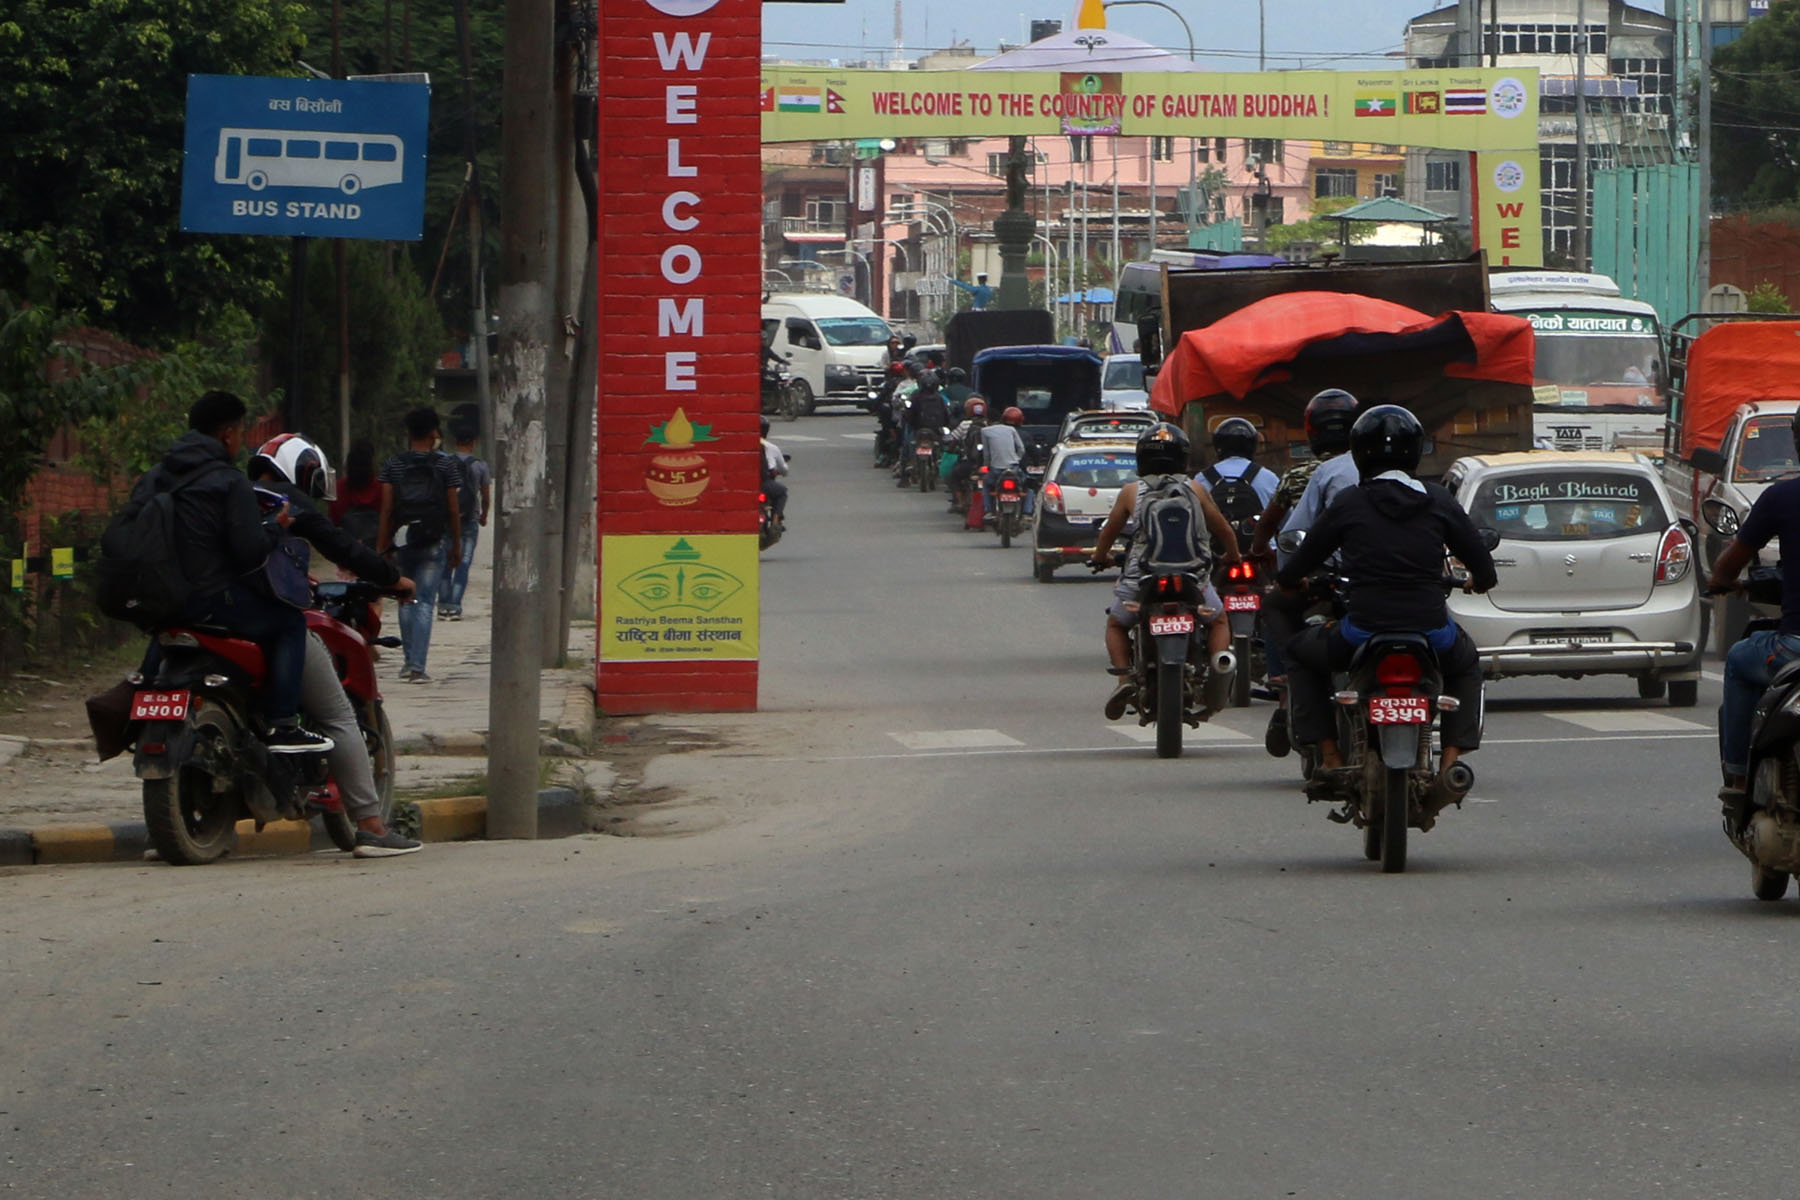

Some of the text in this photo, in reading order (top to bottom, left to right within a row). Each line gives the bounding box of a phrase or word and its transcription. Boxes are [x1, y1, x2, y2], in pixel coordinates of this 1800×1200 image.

[269, 98, 291, 111] बस
[872, 91, 962, 117] WELCOME
[968, 92, 992, 117] TO
[997, 93, 1034, 118] THE
[1039, 93, 1128, 118] COUNTRY
[1133, 94, 1157, 118] OF
[1161, 94, 1237, 118] GAUTAM
[1243, 94, 1319, 118] BUDDHA
[232, 199, 361, 220] BUS STAND
[652, 31, 712, 391] WELCOME
[1527, 313, 1628, 331] निको यातायात
[1555, 428, 1583, 439] TATA
[1073, 458, 1108, 466] ROYAL
[1494, 480, 1640, 501] Bagh Bhairab
[1498, 507, 1520, 518] TAXI
[1593, 510, 1615, 520] TAXI
[615, 615, 743, 626] Rastriya Beema Sansthan
[663, 627, 692, 641] बीमा
[695, 628, 743, 642] संस्थान
[136, 705, 184, 717] ७५००
[1371, 708, 1427, 722] ३३५१
